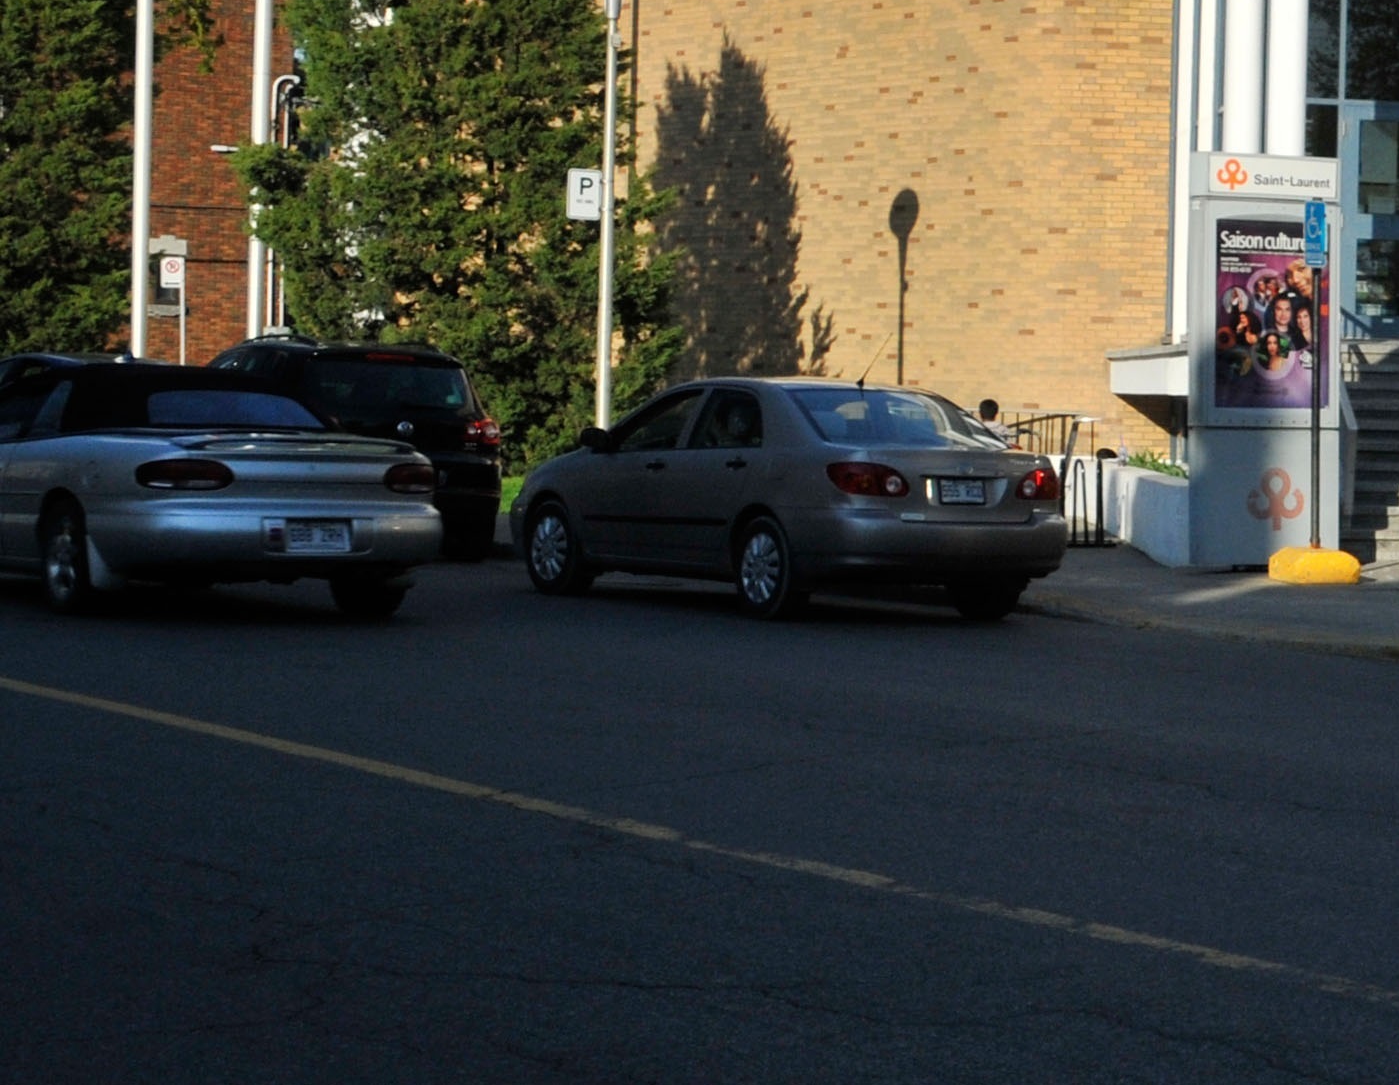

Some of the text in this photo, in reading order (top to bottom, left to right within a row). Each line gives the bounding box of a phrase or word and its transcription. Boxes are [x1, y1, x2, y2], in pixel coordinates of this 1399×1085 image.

[580, 177, 593, 195] P
[1253, 173, 1331, 189] Saint-Laurent
[1220, 230, 1263, 249] Saison
